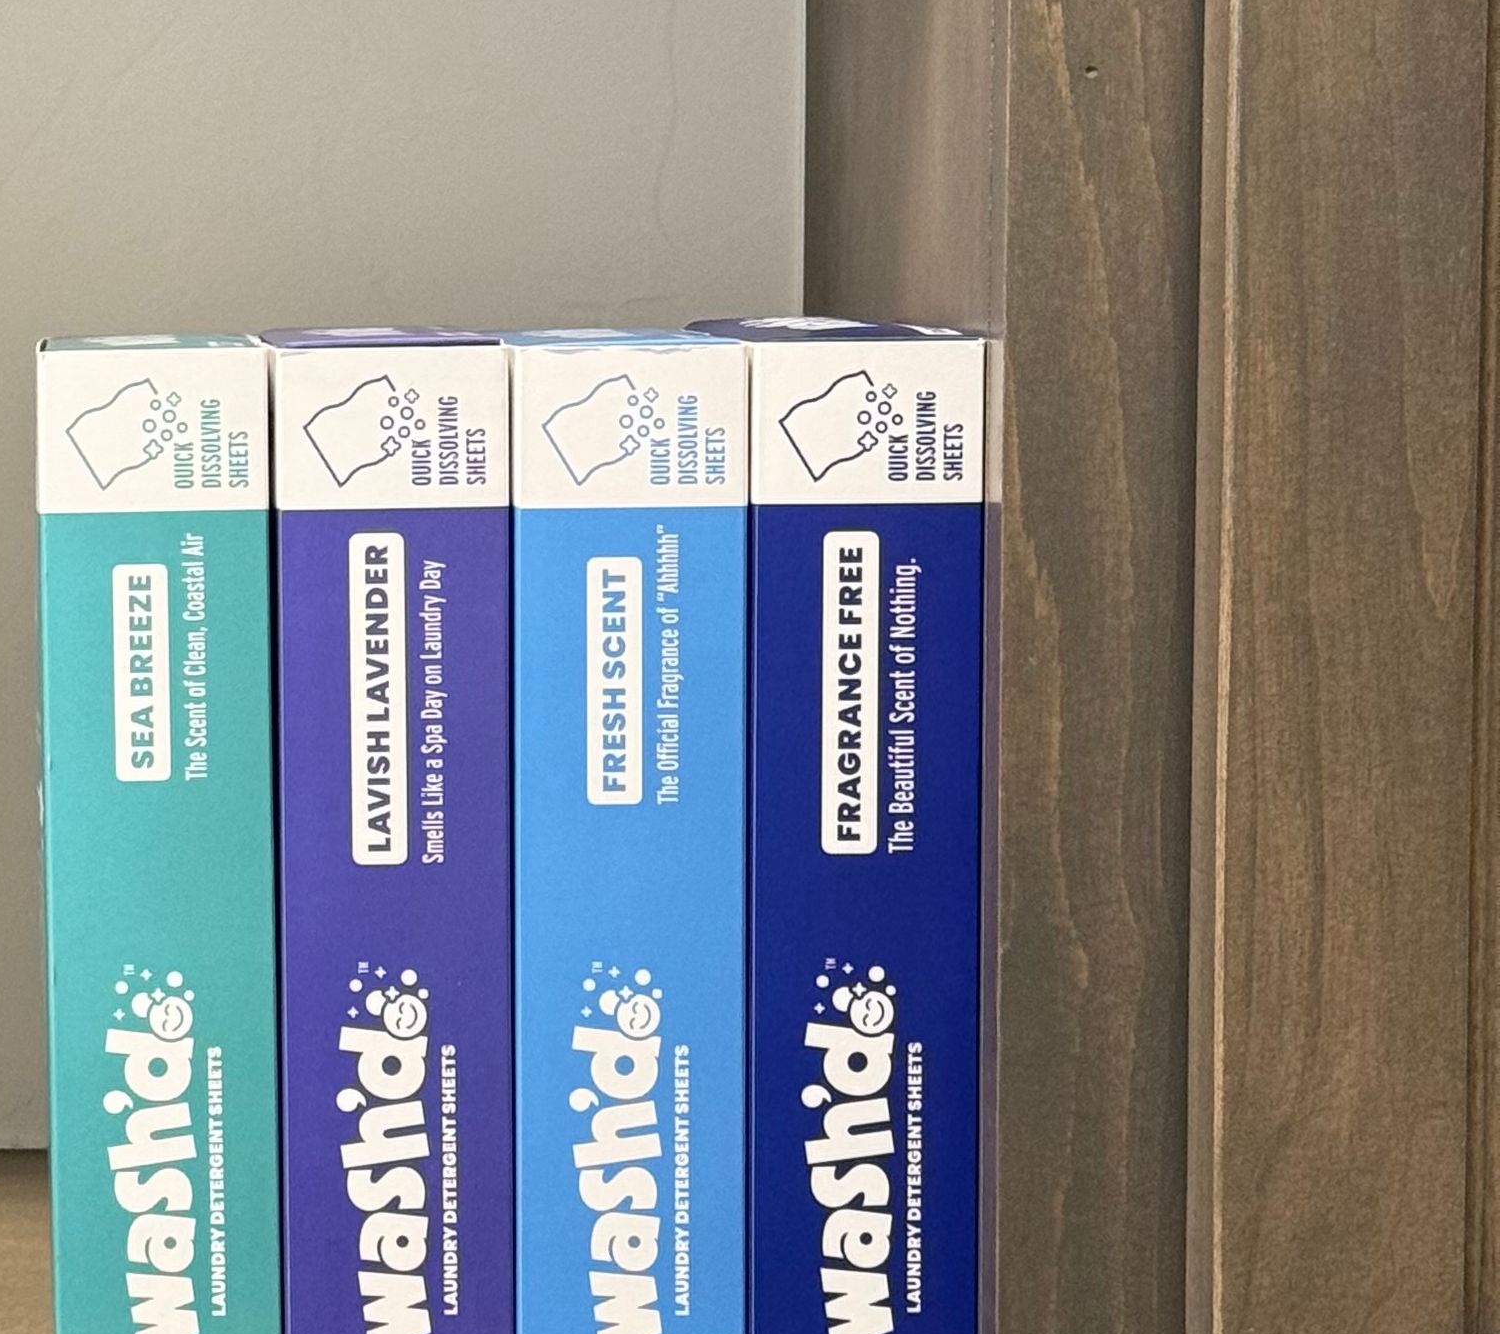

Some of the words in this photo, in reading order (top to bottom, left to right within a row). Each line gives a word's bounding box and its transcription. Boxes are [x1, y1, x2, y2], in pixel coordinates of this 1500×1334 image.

[173, 441, 195, 489] QUICK
[199, 398, 222, 489] DISSOLVING
[227, 430, 250, 489] SHEETS
[411, 439, 432, 486] QUICK
[437, 396, 459, 486] DISSOLVING
[465, 428, 487, 486] SHEETS
[649, 437, 671, 486] QUICK
[677, 395, 699, 485] DISSOLVING
[704, 427, 726, 485] SHEETS
[887, 434, 909, 482] QUICK
[915, 391, 937, 481] DISSOLVING
[942, 423, 964, 482] SHEETS
[180, 532, 205, 557] Air
[418, 560, 447, 590] Day
[181, 561, 206, 621] Coastal
[655, 606, 680, 624] of
[838, 547, 863, 625] FREE
[889, 558, 922, 638] Nothing.
[127, 575, 154, 697] BREEZE
[182, 626, 209, 676] Clean,
[364, 545, 390, 722] LAVENDER
[418, 594, 447, 660] Laundry
[601, 568, 626, 680] SCENT
[888, 644, 916, 664] of
[182, 679, 207, 698] of
[424, 664, 443, 685] on
[656, 628, 685, 709] Fragrance
[888, 670, 916, 723] Scent
[130, 704, 155, 769] SEA
[183, 701, 208, 748] Scent
[420, 689, 448, 719] Day
[184, 751, 208, 782] The
[420, 724, 448, 754] Spa
[425, 758, 444, 769] a
[602, 687, 627, 792] FRESH
[656, 714, 680, 771] Official
[836, 633, 862, 842] FRAGRANCE
[366, 730, 392, 853] LAVISH
[420, 773, 444, 806] Like
[656, 775, 680, 806] The
[887, 729, 915, 814] Beautiful
[421, 810, 444, 864] Smells
[887, 820, 915, 854] The
[206, 1046, 223, 1116] SHEETS
[441, 1044, 457, 1114] SHEETS
[674, 1044, 690, 1115] SHEETS
[907, 1042, 923, 1112] SHEETS
[208, 1117, 225, 1225] DETERGENT
[441, 1115, 458, 1224] DETERGENT
[674, 1116, 690, 1225] DETERGENT
[906, 1113, 923, 1221] DETERGENT
[209, 1227, 227, 1317] LAUNDRY
[442, 1226, 459, 1316] LAUNDRY
[674, 1226, 690, 1316] LAUNDRY
[906, 1223, 922, 1313] LAUNDRY
